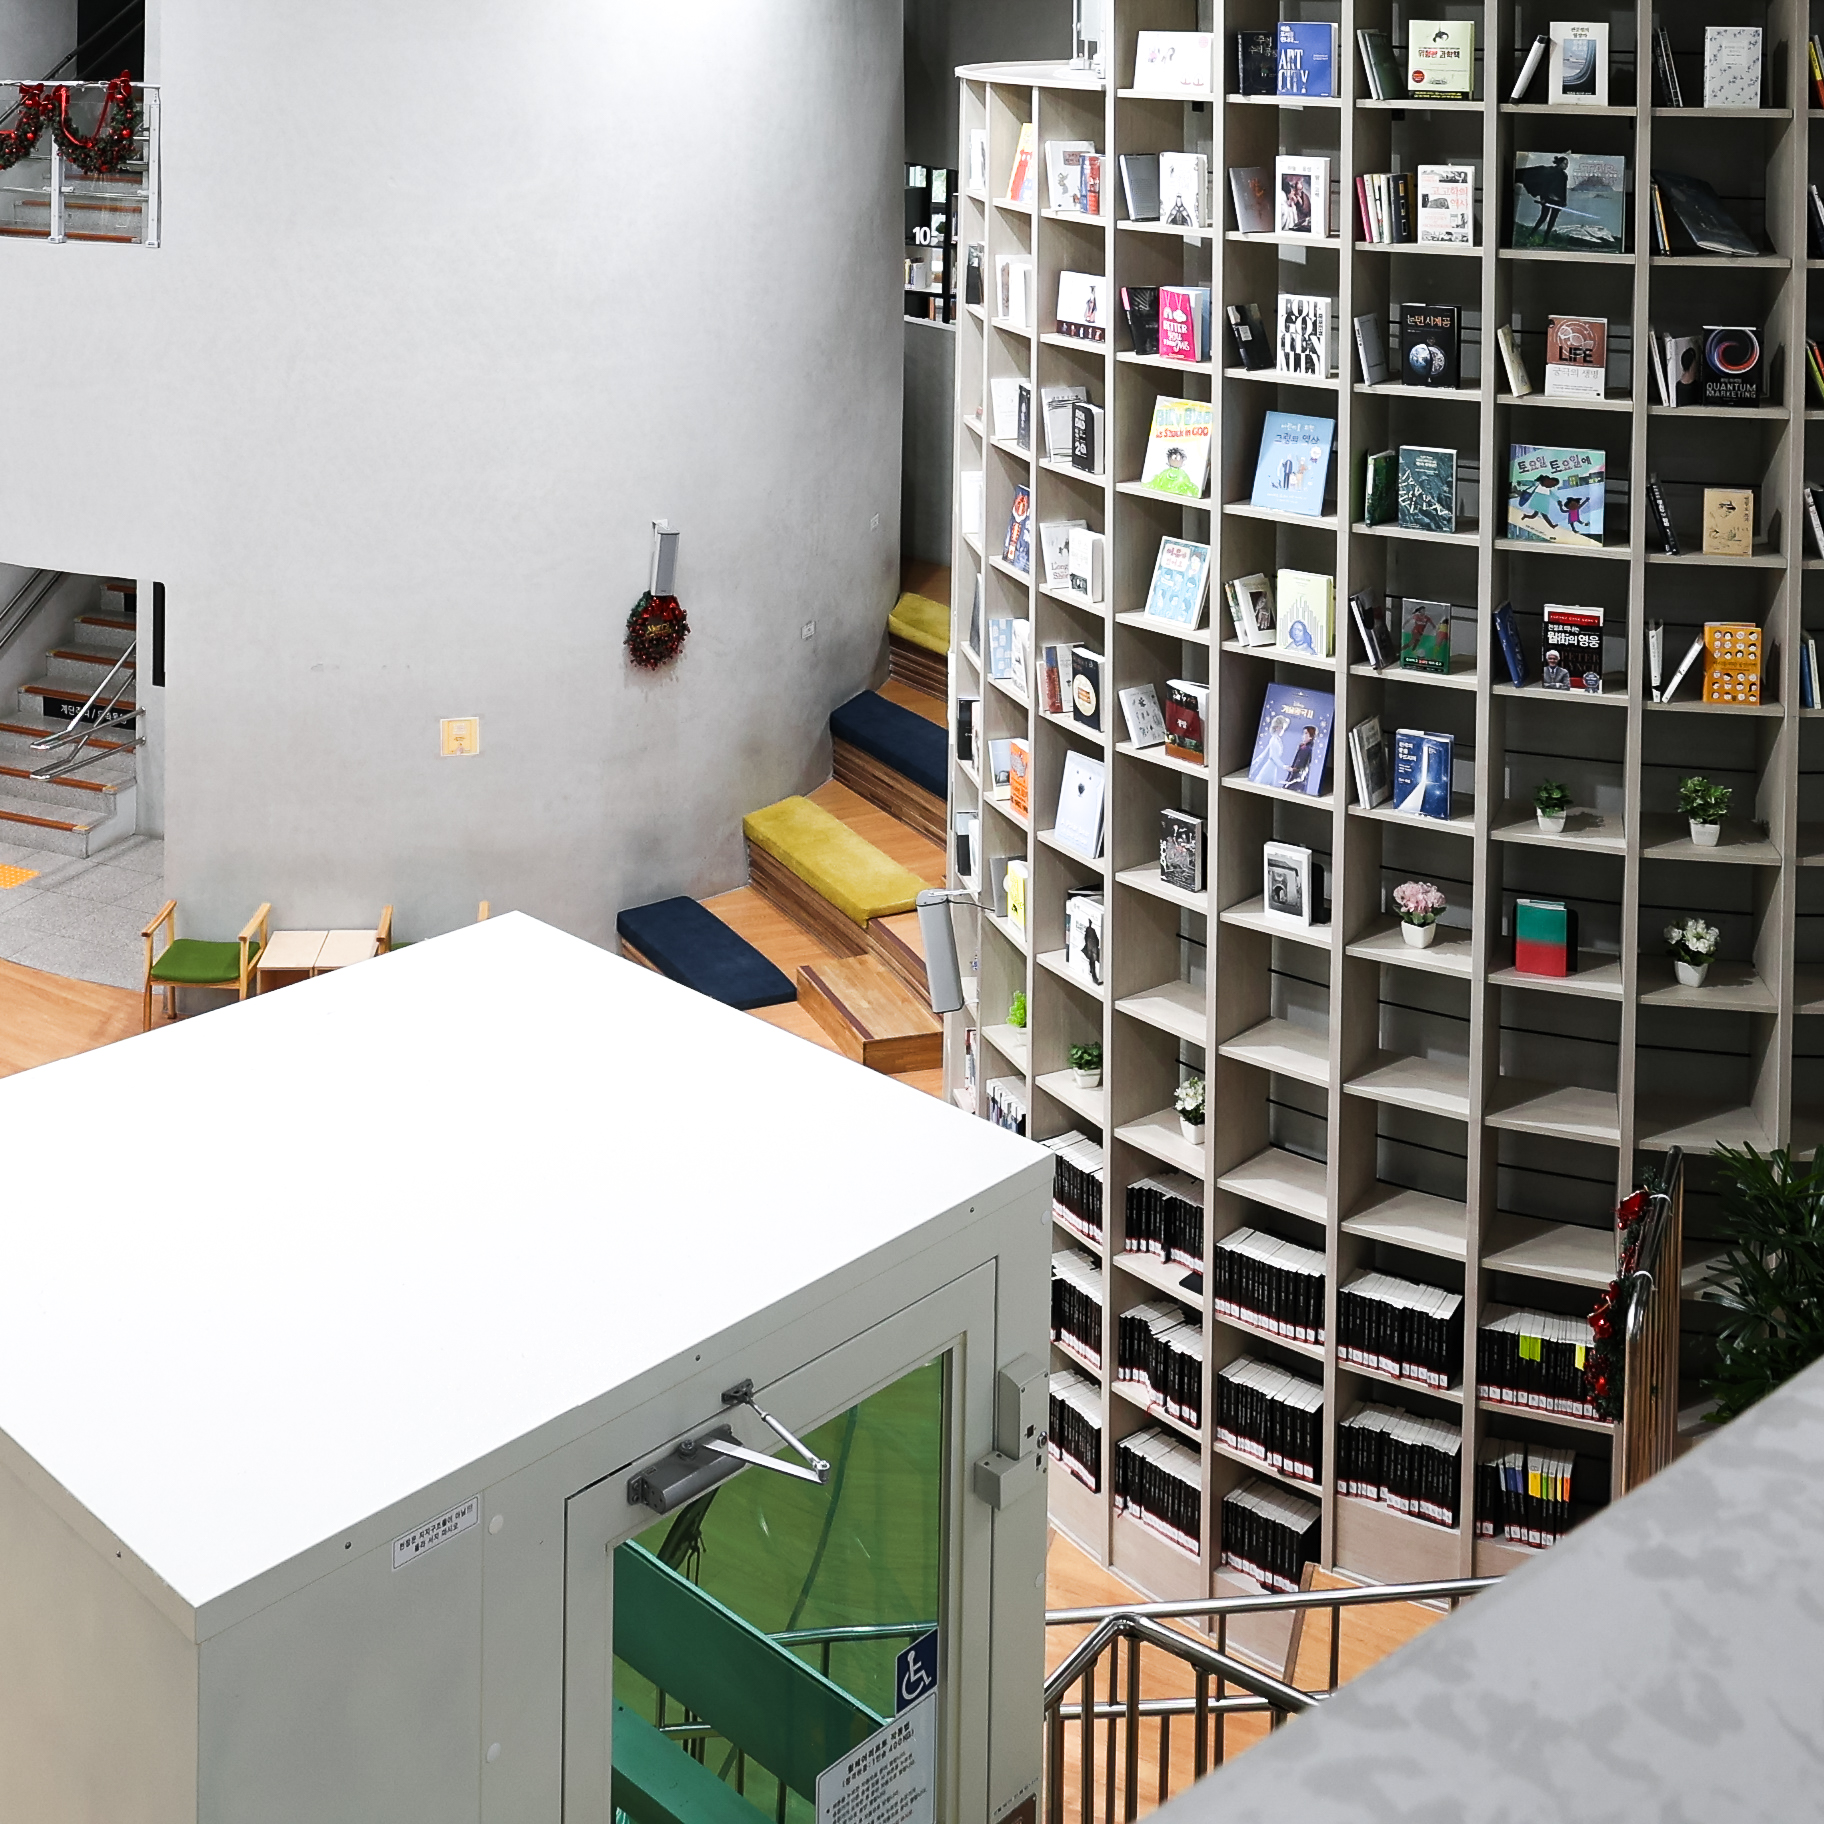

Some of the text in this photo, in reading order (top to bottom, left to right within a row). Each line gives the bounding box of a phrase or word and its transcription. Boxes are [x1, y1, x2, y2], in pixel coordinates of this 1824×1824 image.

[1278, 48, 1304, 70] ART
[1418, 49, 1460, 59] 위험한 과학책
[1278, 69, 1309, 94] CITY
[1574, 163, 1617, 173] STAR
[1450, 199, 1468, 208] 역사
[1406, 314, 1451, 327] 눈먼 시계공
[1558, 345, 1594, 364] LIFE
[1552, 366, 1599, 379] 궁극의 생명
[1706, 382, 1757, 391] QUANTUM
[1706, 390, 1757, 399] MARKETING
[1191, 426, 1208, 437] GOO
[1517, 454, 1592, 475] 토요일 토요일에
[1578, 634, 1600, 648] 영웅
[1561, 652, 1600, 662] PETER
